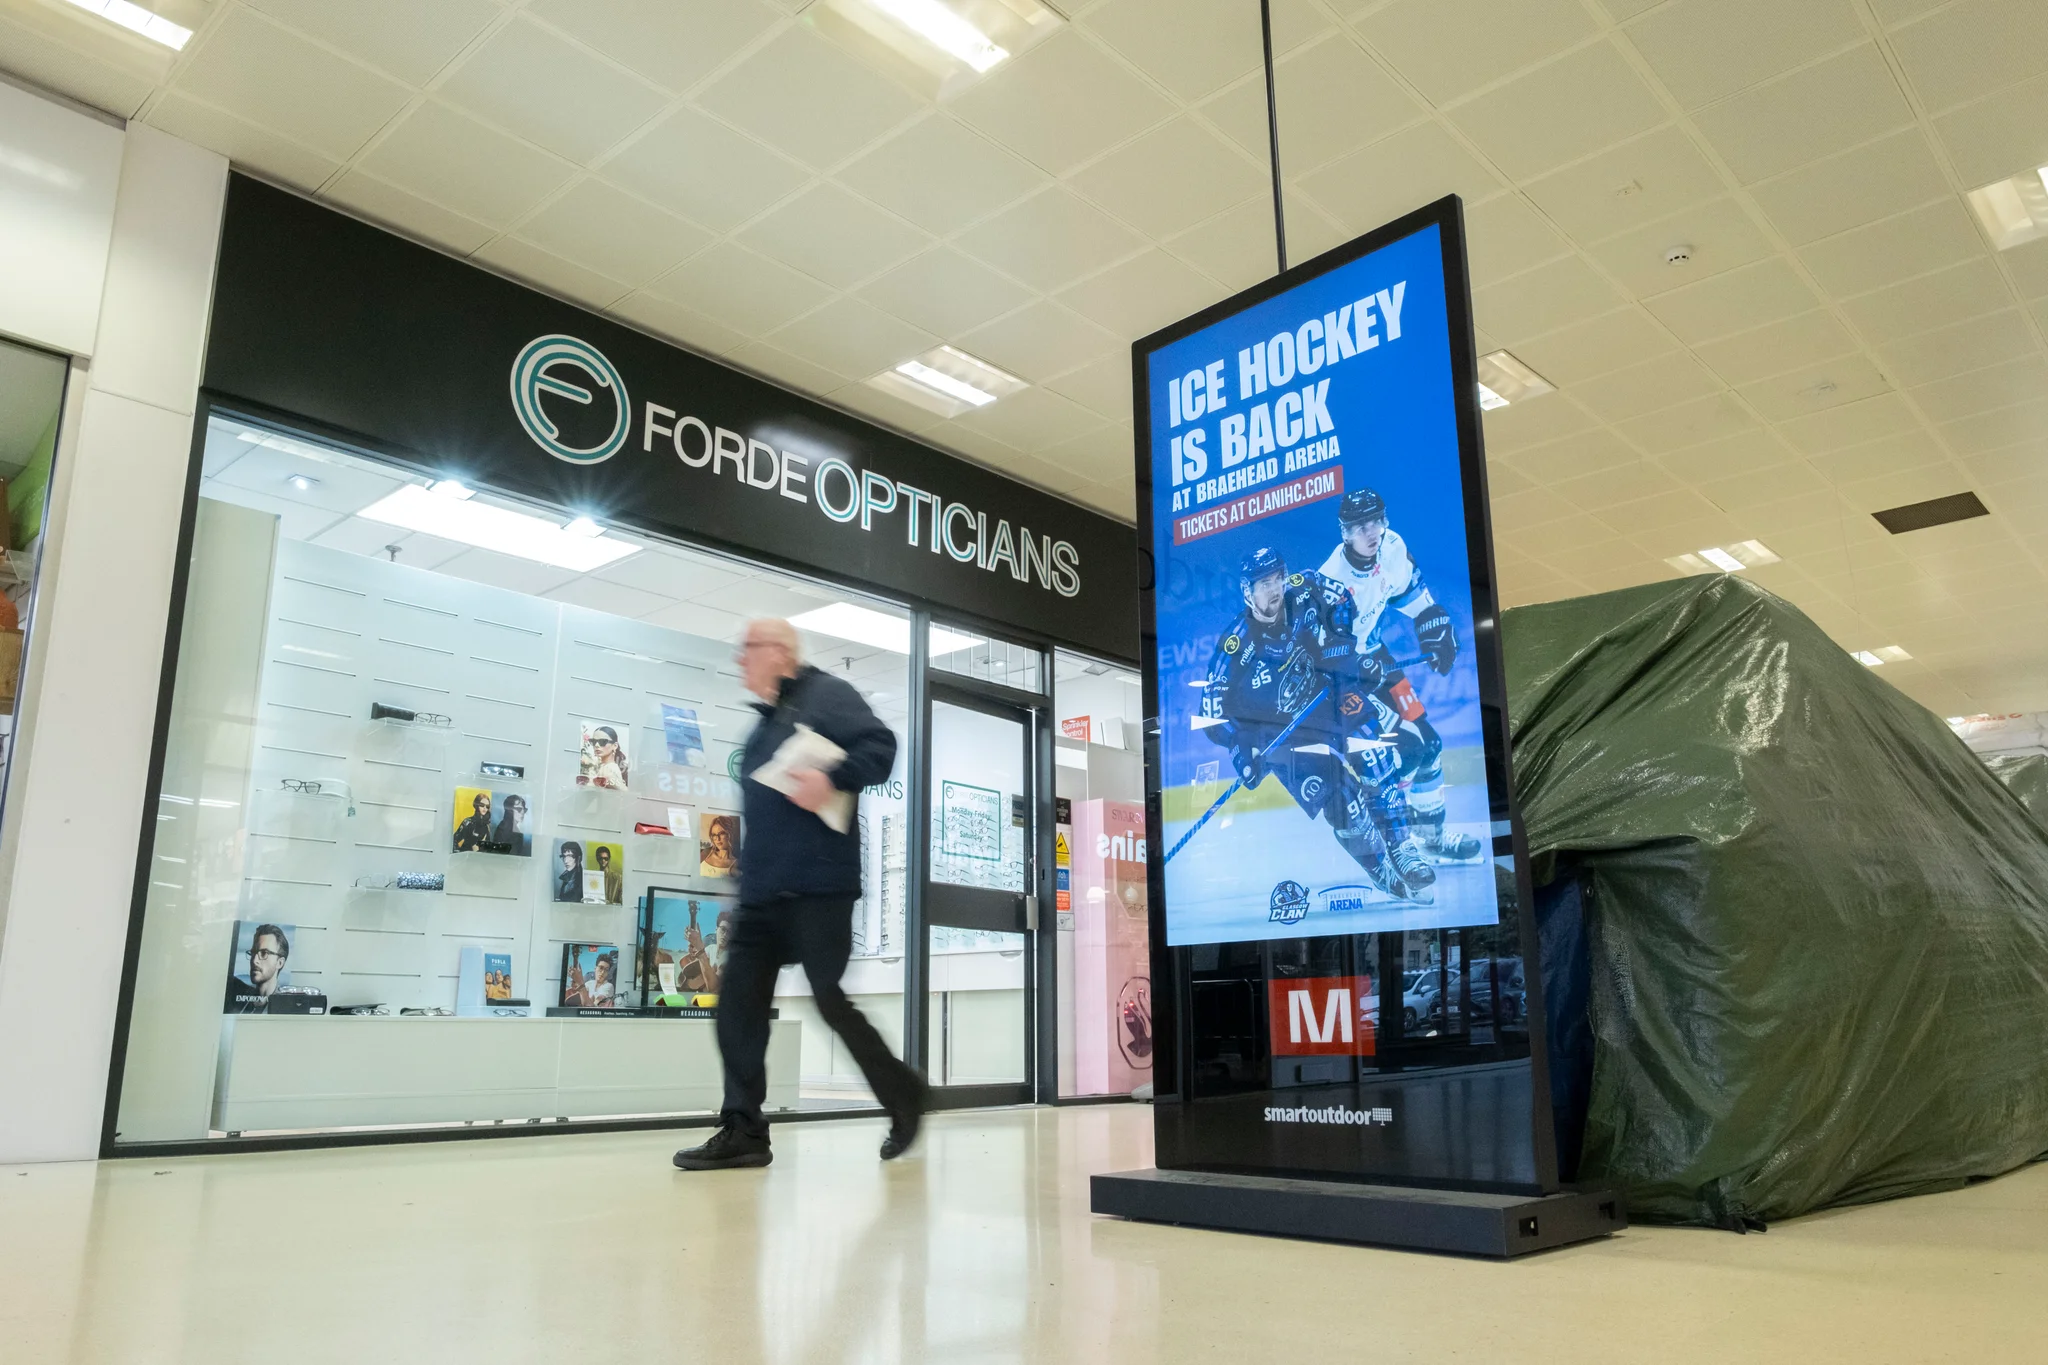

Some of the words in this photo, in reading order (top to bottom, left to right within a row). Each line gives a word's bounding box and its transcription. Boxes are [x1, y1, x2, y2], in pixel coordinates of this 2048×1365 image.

[1168, 359, 1227, 429] ICE
[1238, 280, 1407, 400] HOCKEY
[1170, 428, 1208, 487] IS
[1220, 378, 1335, 469] BACK
[1172, 488, 1191, 512] AT
[1196, 457, 1279, 505] BRAEHEAD
[1284, 435, 1341, 473] ARENA
[643, 401, 808, 504] FORDE
[813, 457, 1081, 598] OPTICIANS
[1180, 508, 1228, 539] TICKETS
[1229, 500, 1246, 523] AT
[1248, 471, 1335, 518] CLANIHC.COM
[1295, 591, 1311, 606] APC
[1239, 640, 1256, 667] miller
[1251, 669, 1272, 690] 95
[1202, 696, 1223, 719] 95
[1306, 781, 1321, 797] 10
[1270, 908, 1306, 921] CLAN
[1329, 898, 1363, 912] ARENA
[1288, 988, 1353, 1043] M
[1264, 1104, 1372, 1126] smartoutdoor
